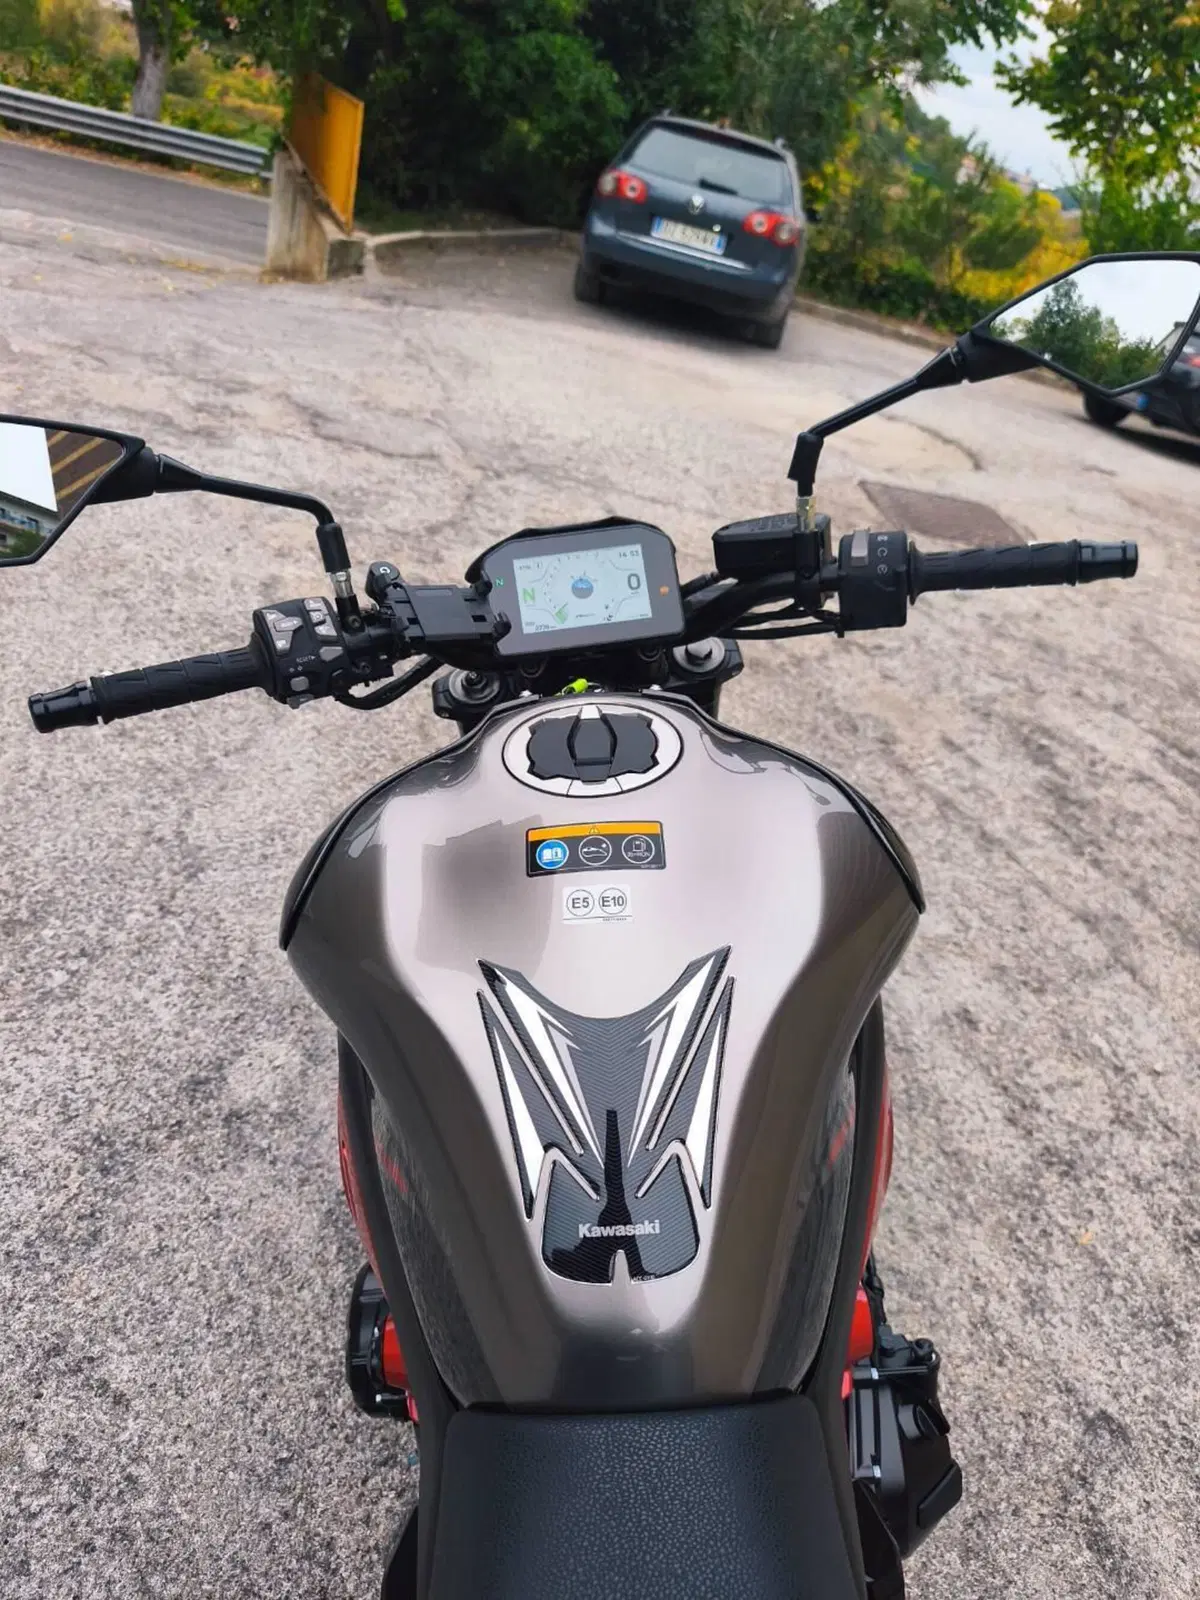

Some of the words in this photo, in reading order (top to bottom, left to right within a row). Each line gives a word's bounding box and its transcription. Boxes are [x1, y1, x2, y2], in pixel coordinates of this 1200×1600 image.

[627, 573, 641, 590] 0
[522, 588, 536, 604] N
[571, 897, 590, 909] E5
[601, 895, 625, 908] E10
[578, 1219, 660, 1238] Kawasaki
